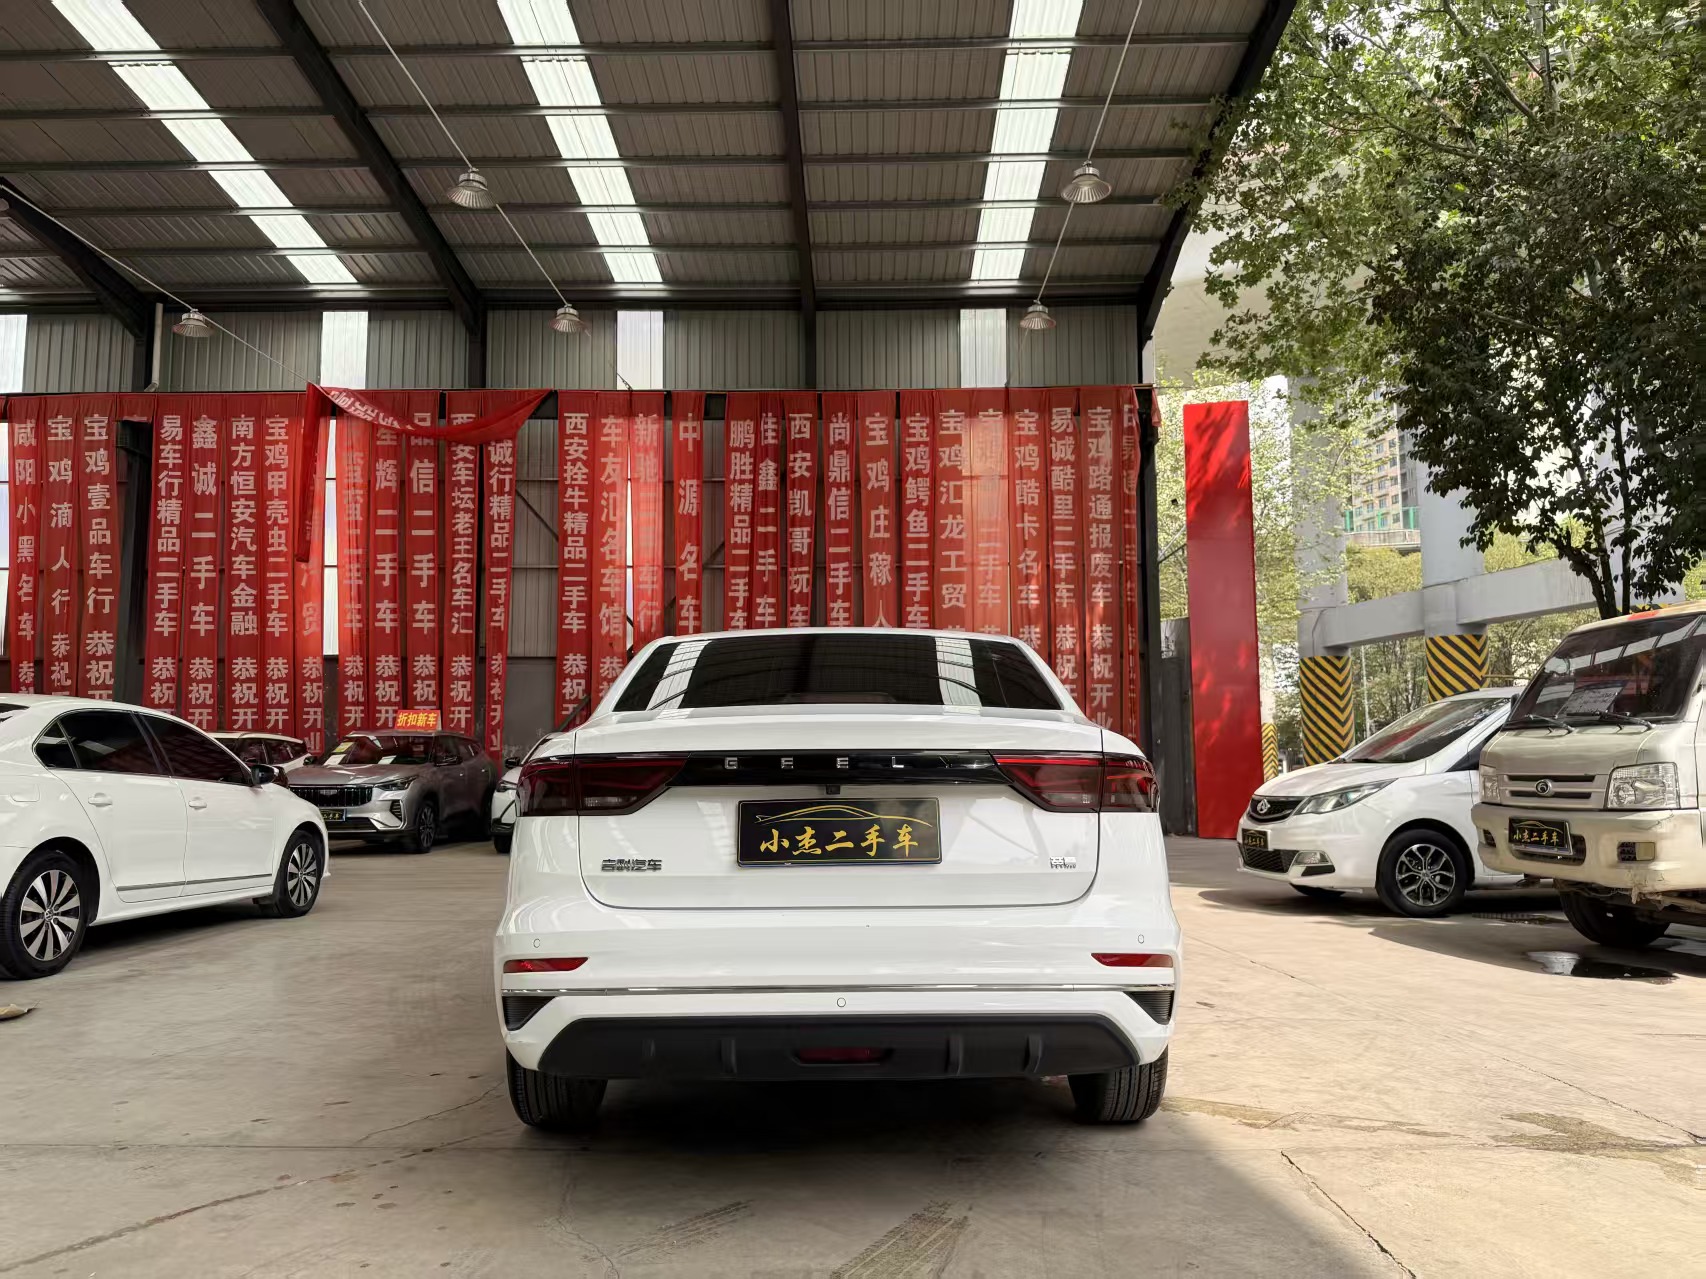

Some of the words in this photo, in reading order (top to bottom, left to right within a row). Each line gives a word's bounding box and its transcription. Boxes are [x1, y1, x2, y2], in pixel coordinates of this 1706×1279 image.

[14, 419, 37, 641] 咸阳小黑名车
[84, 413, 116, 614] 宝鸡壹品车行
[154, 414, 184, 637] 易车行精品二手车
[190, 414, 217, 637] 鑫诚二手车
[230, 414, 259, 636] 南方恒安汽车金融
[265, 414, 290, 637] 宝鸡甲壳虫二手车
[562, 412, 590, 634] 西安拴牛精品二手车
[755, 411, 779, 628] 佳鑫二手车
[828, 411, 851, 628] 尚鼎信二手车
[905, 412, 931, 629] 宝鸡鳄鱼二手车
[938, 408, 967, 609] 宝鸡汇龙工贸
[1014, 407, 1041, 609] 宝鸡酷卡名车
[1050, 406, 1077, 608] 易诚酷里二手车
[1087, 406, 1114, 607] 宝鸡路通报废车
[396, 711, 438, 727] 折扣新车
[759, 824, 921, 858] 小杰二手车
